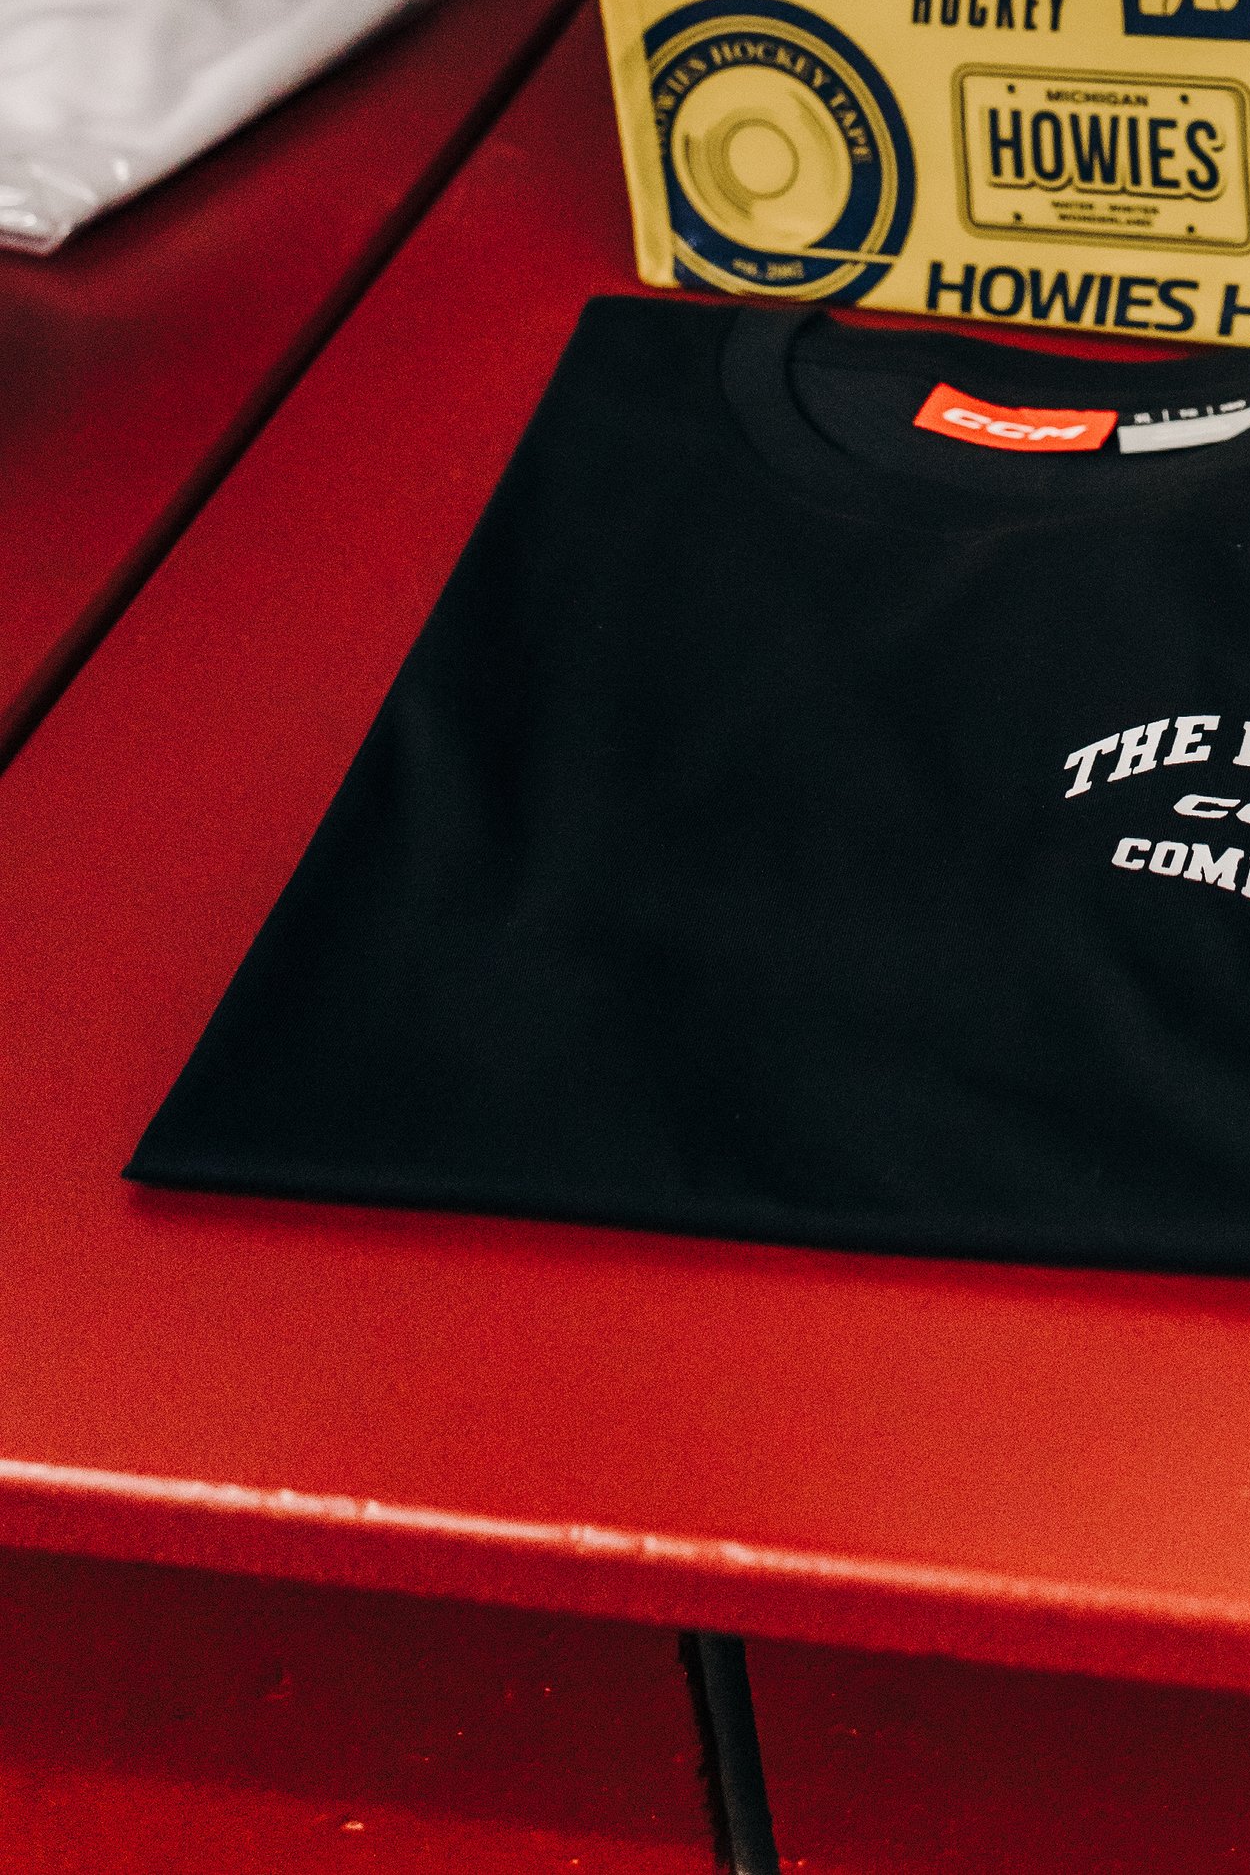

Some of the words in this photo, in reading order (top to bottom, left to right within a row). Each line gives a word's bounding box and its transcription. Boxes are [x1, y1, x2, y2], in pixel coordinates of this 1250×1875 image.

[709, 39, 831, 89] HOCKEY
[1046, 89, 1149, 107] MICHIGAN
[988, 107, 1221, 193] HOWIES
[926, 262, 1199, 332] HOWIES
[943, 407, 1087, 440] CCM
[1064, 715, 1221, 799] THE
